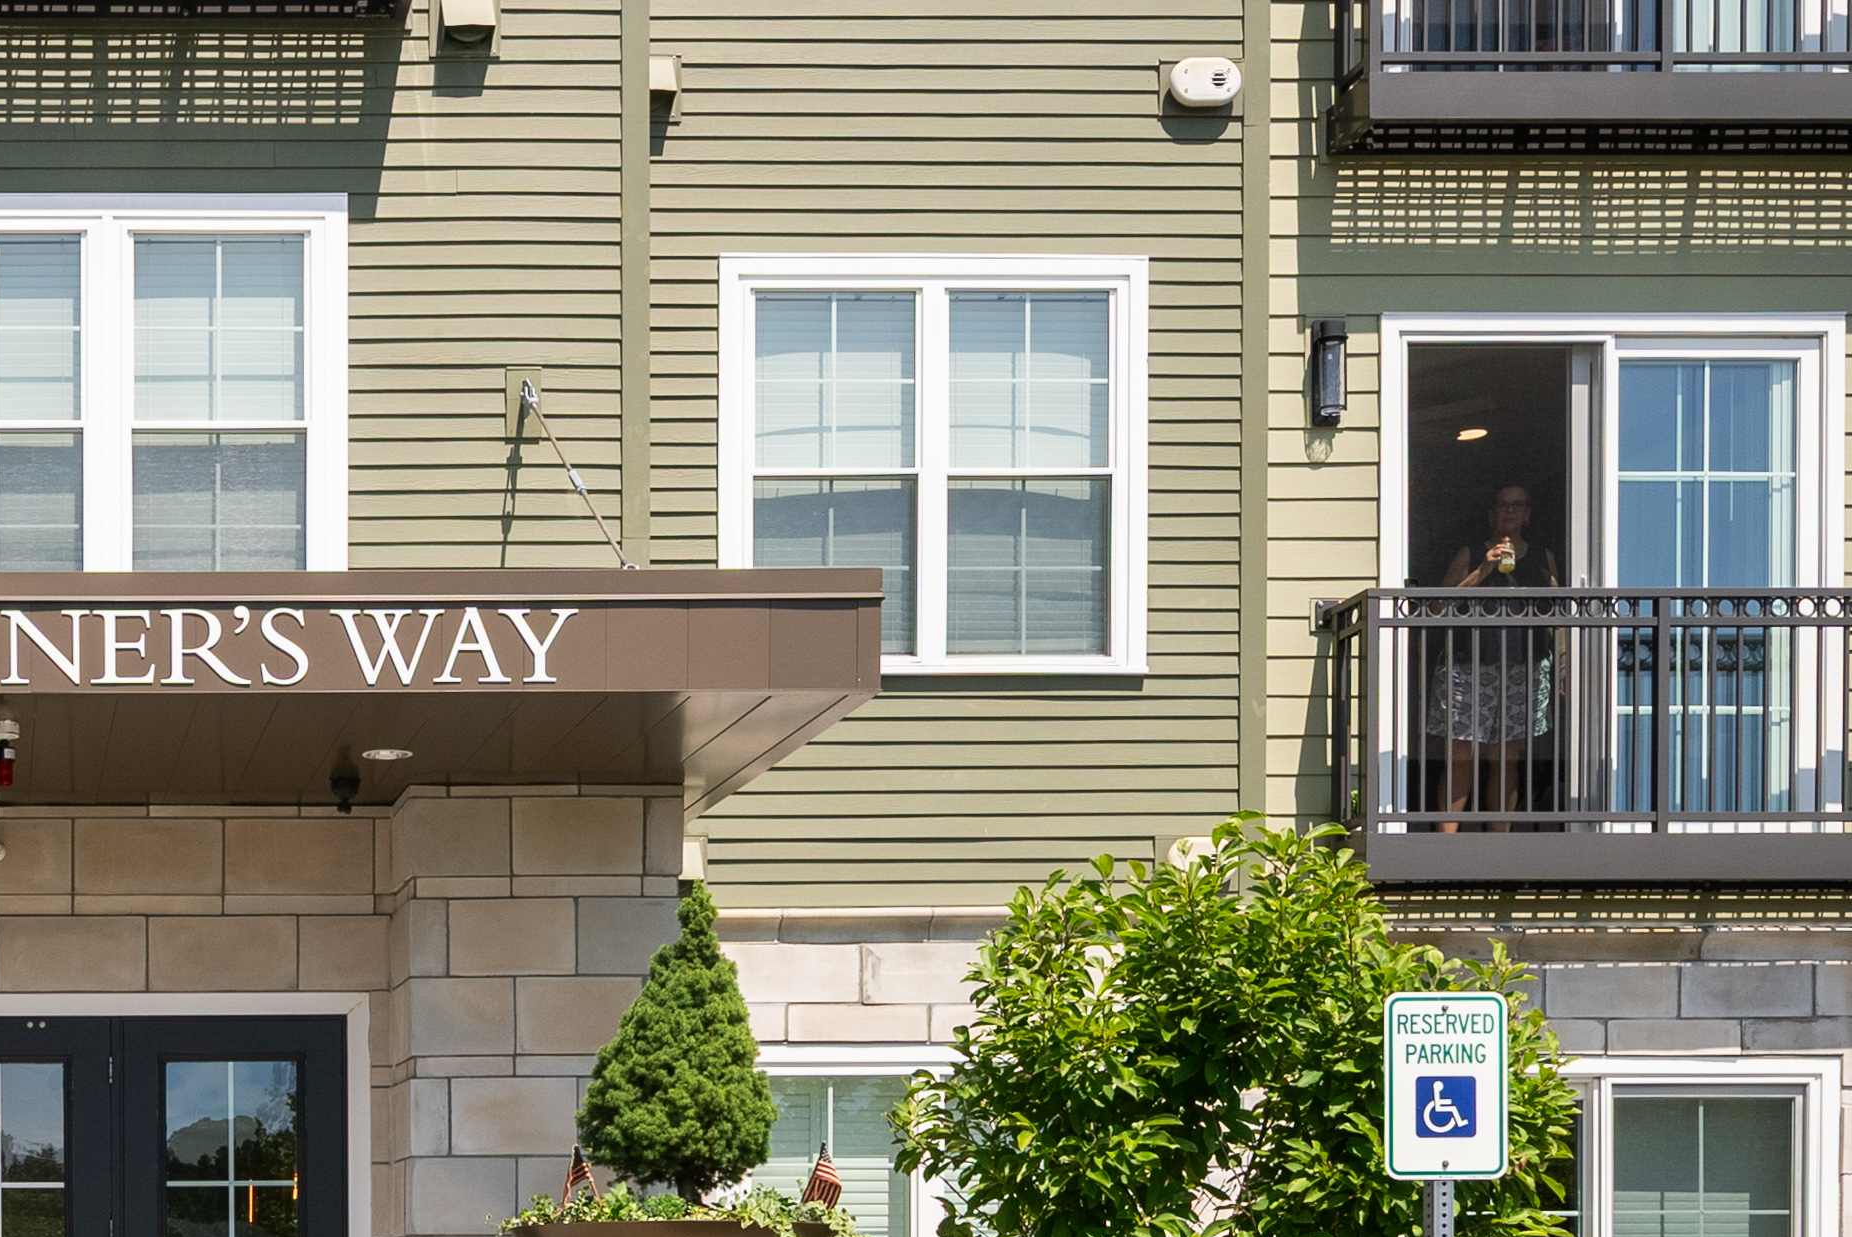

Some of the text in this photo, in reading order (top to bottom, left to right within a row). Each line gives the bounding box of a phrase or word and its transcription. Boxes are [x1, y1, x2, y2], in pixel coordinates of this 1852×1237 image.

[329, 607, 579, 685] WAY
[1397, 1013, 1495, 1034] RESERVED
[1405, 1043, 1486, 1064] PARKING
